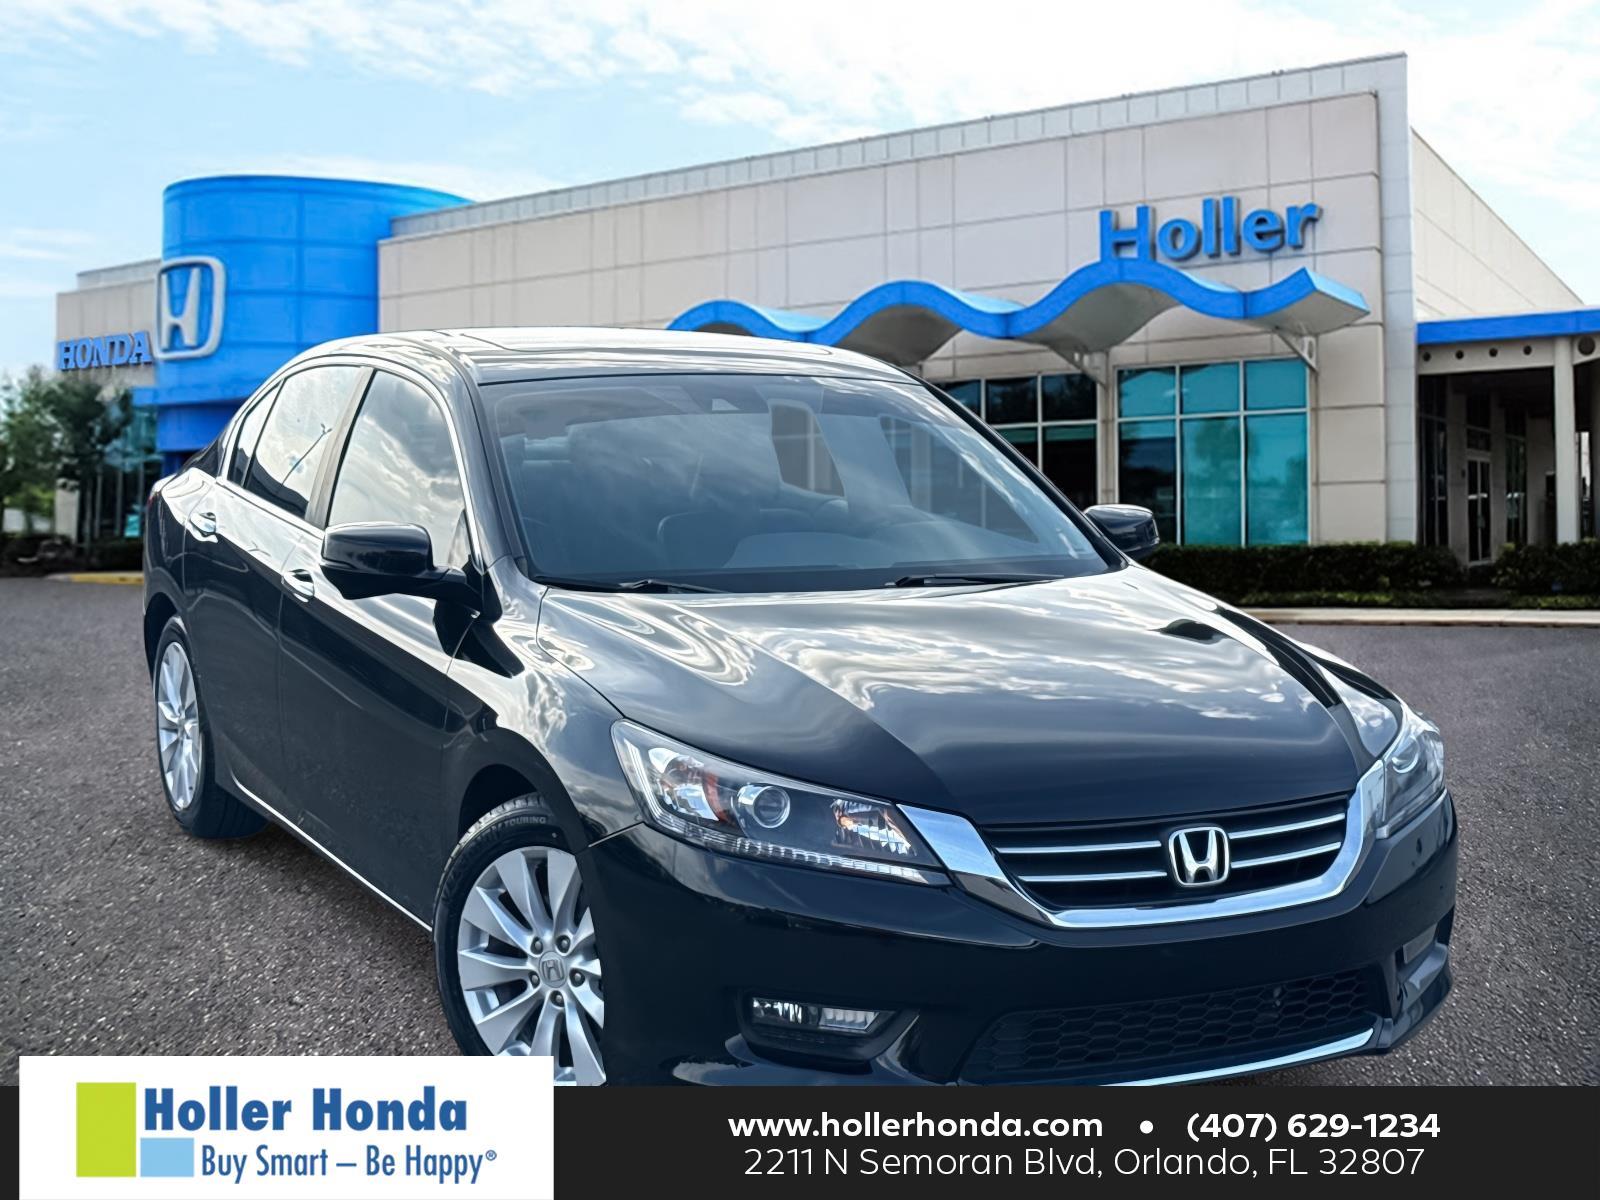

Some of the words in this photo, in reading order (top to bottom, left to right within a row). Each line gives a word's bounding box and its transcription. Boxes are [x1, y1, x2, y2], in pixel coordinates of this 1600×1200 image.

[1099, 195, 1323, 261] Holler
[57, 330, 152, 371] HONDA
[504, 815, 547, 827] TOURING
